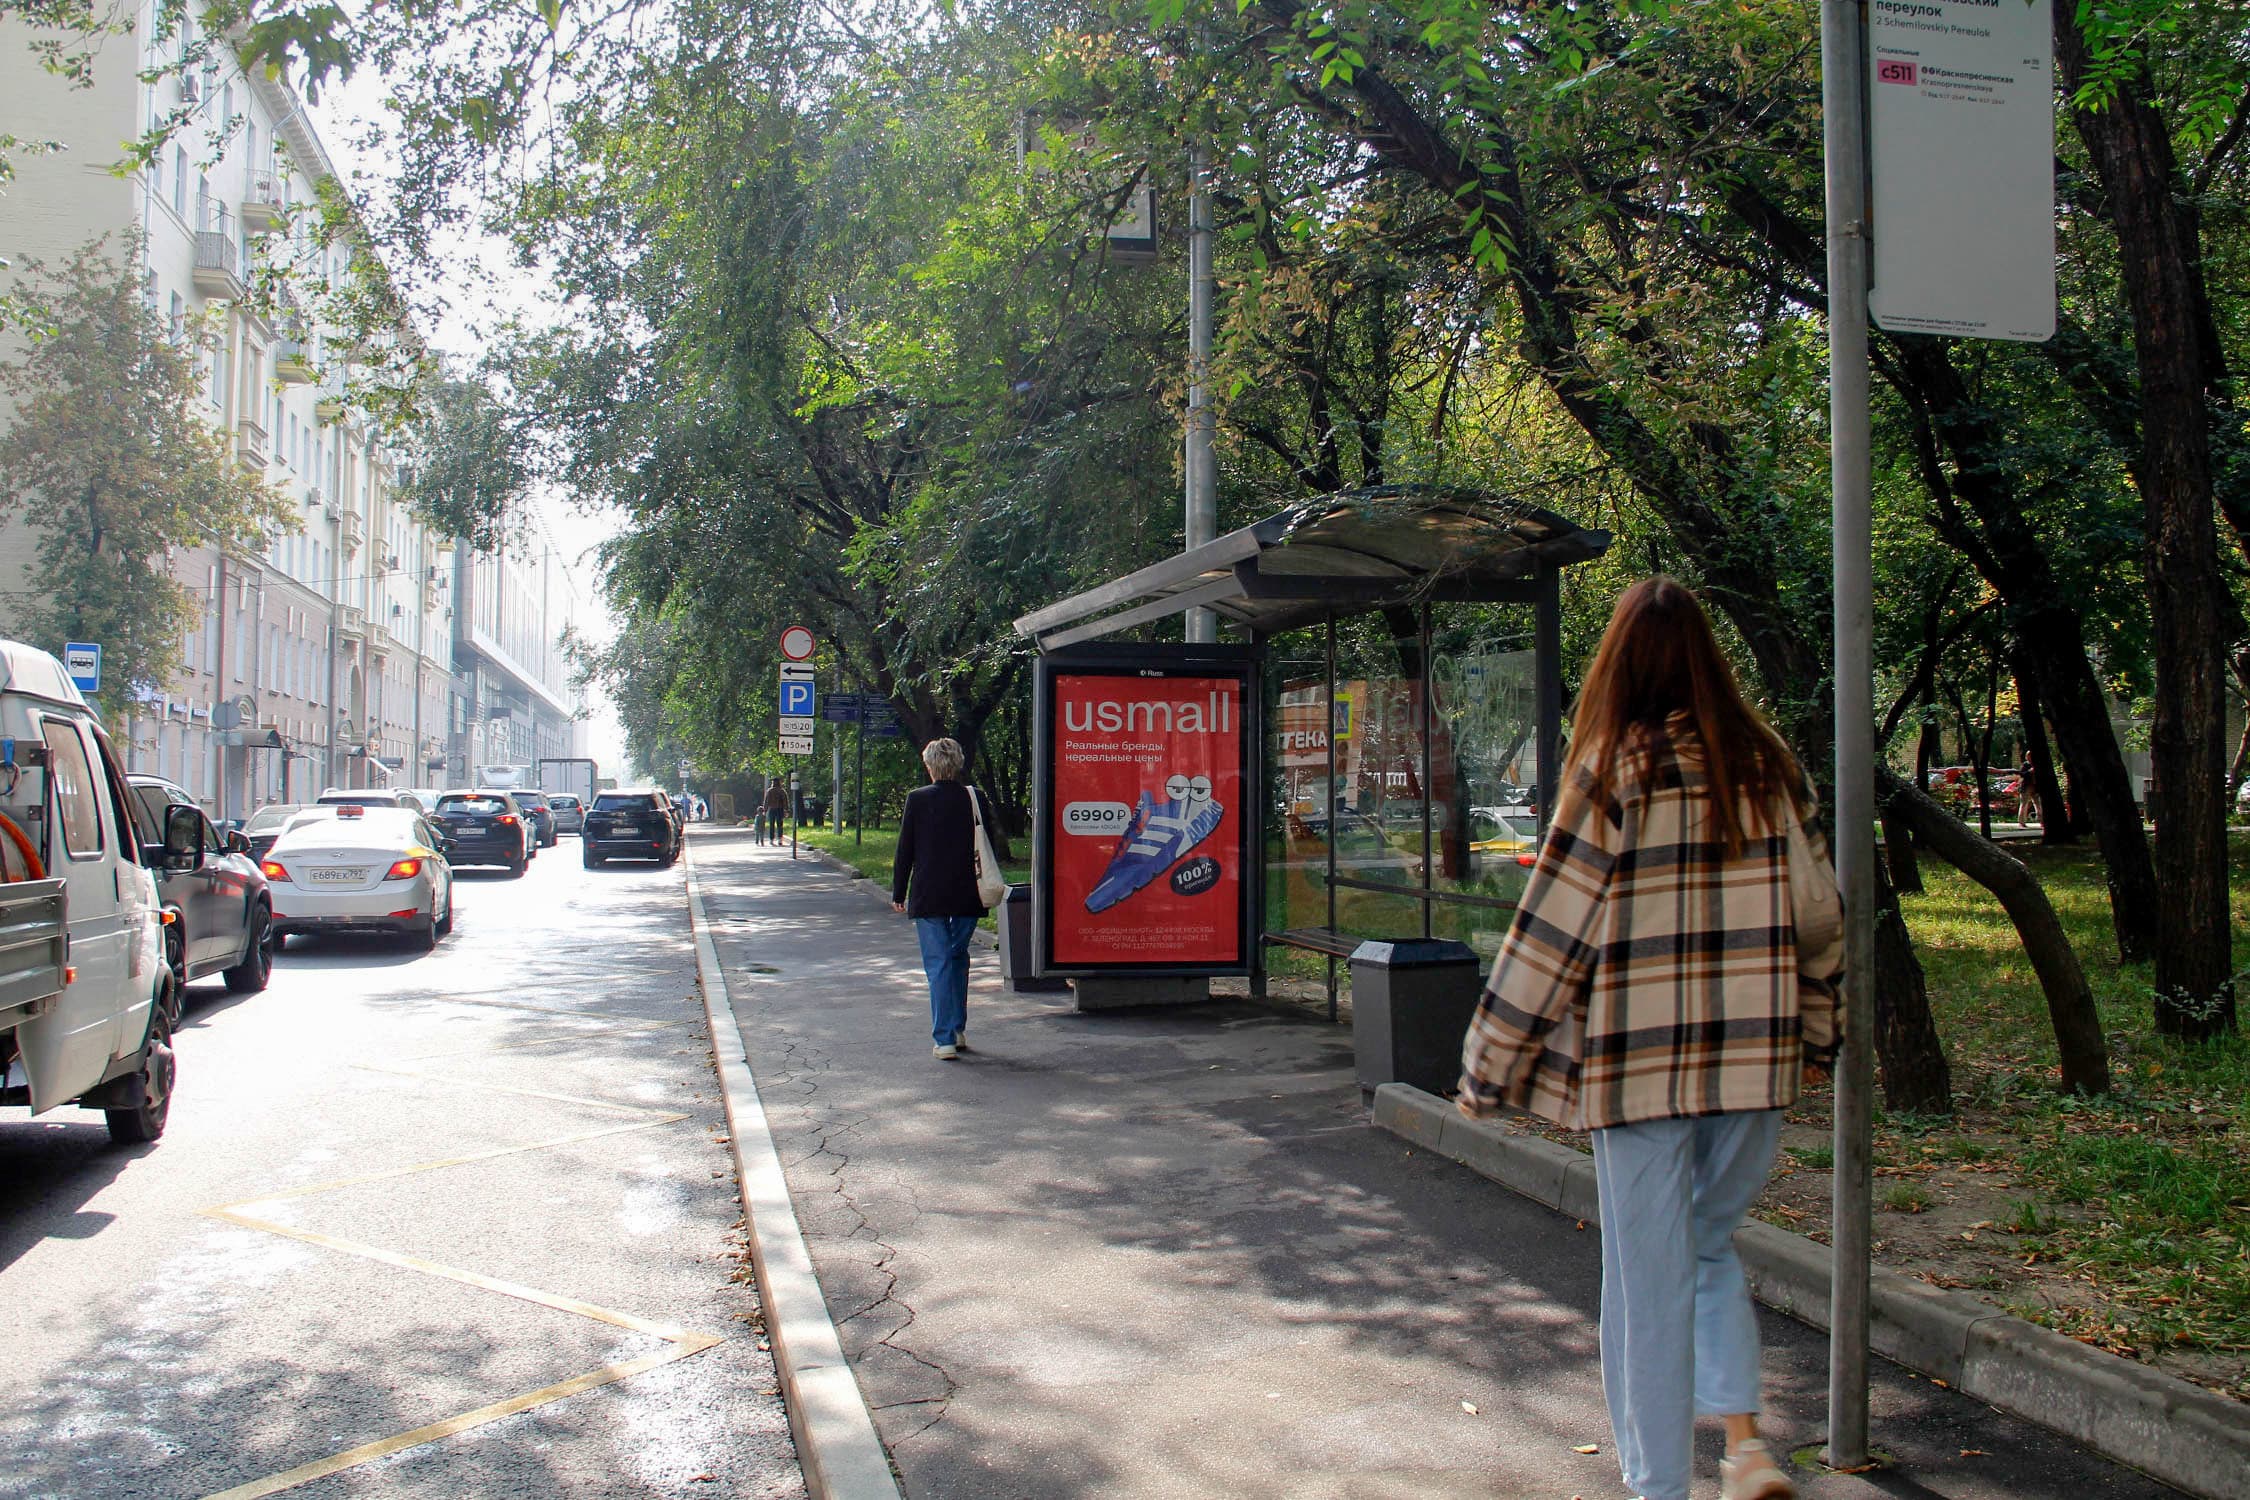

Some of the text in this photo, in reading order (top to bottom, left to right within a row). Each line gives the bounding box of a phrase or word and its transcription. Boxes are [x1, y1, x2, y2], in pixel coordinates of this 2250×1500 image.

[1876, 0, 1942, 18] переулок
[1876, 16, 1991, 37] 2 Schemilovskiy Pereulok
[1881, 64, 1912, 81] с511
[789, 685, 808, 712] P
[1065, 691, 1229, 733] usmall
[786, 741, 800, 749] 150
[1065, 740, 1119, 750] Реальные
[1277, 730, 1328, 750] ТЕКА
[1065, 753, 1163, 764] нереальные цены
[1070, 809, 1115, 822] 6990
[1176, 862, 1213, 885] 100%
